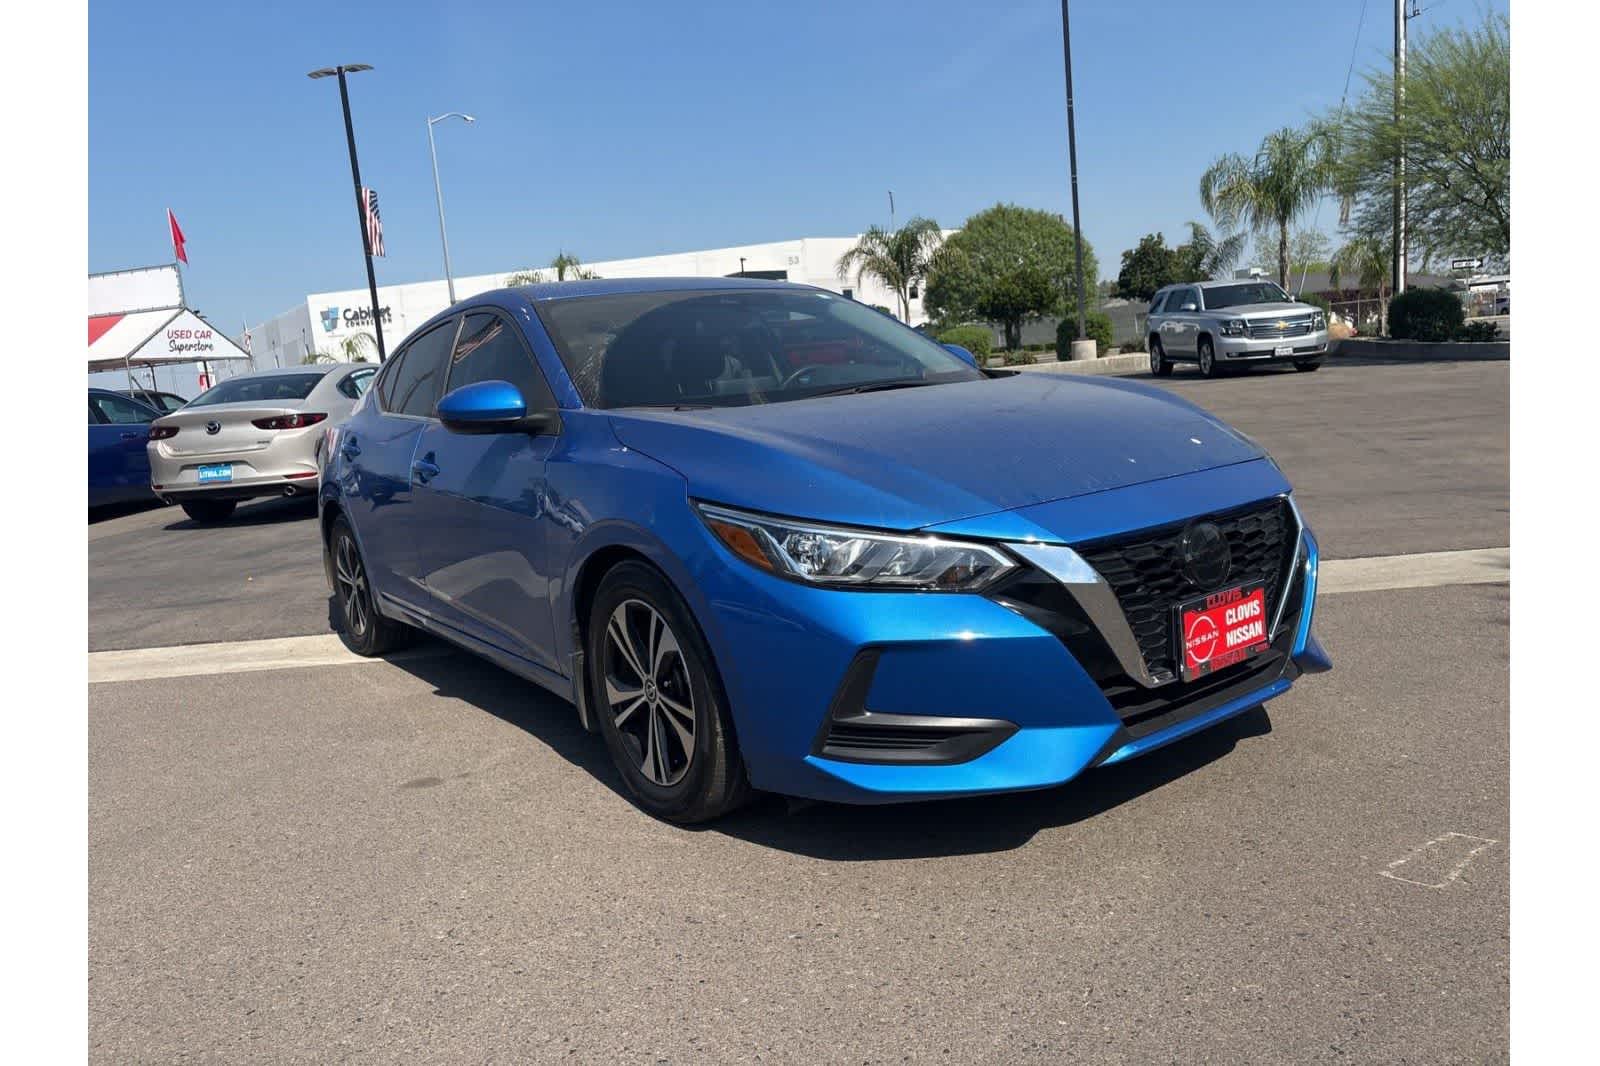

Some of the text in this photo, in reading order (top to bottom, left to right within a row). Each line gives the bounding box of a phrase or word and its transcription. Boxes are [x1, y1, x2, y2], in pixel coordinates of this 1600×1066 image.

[343, 306, 392, 321] Cabiet
[167, 329, 212, 340] USED CAR
[168, 339, 214, 355] Superstore
[1225, 599, 1260, 626] CLOVIS
[1186, 630, 1219, 650] NISSAN
[1225, 620, 1263, 648] NISSAN
